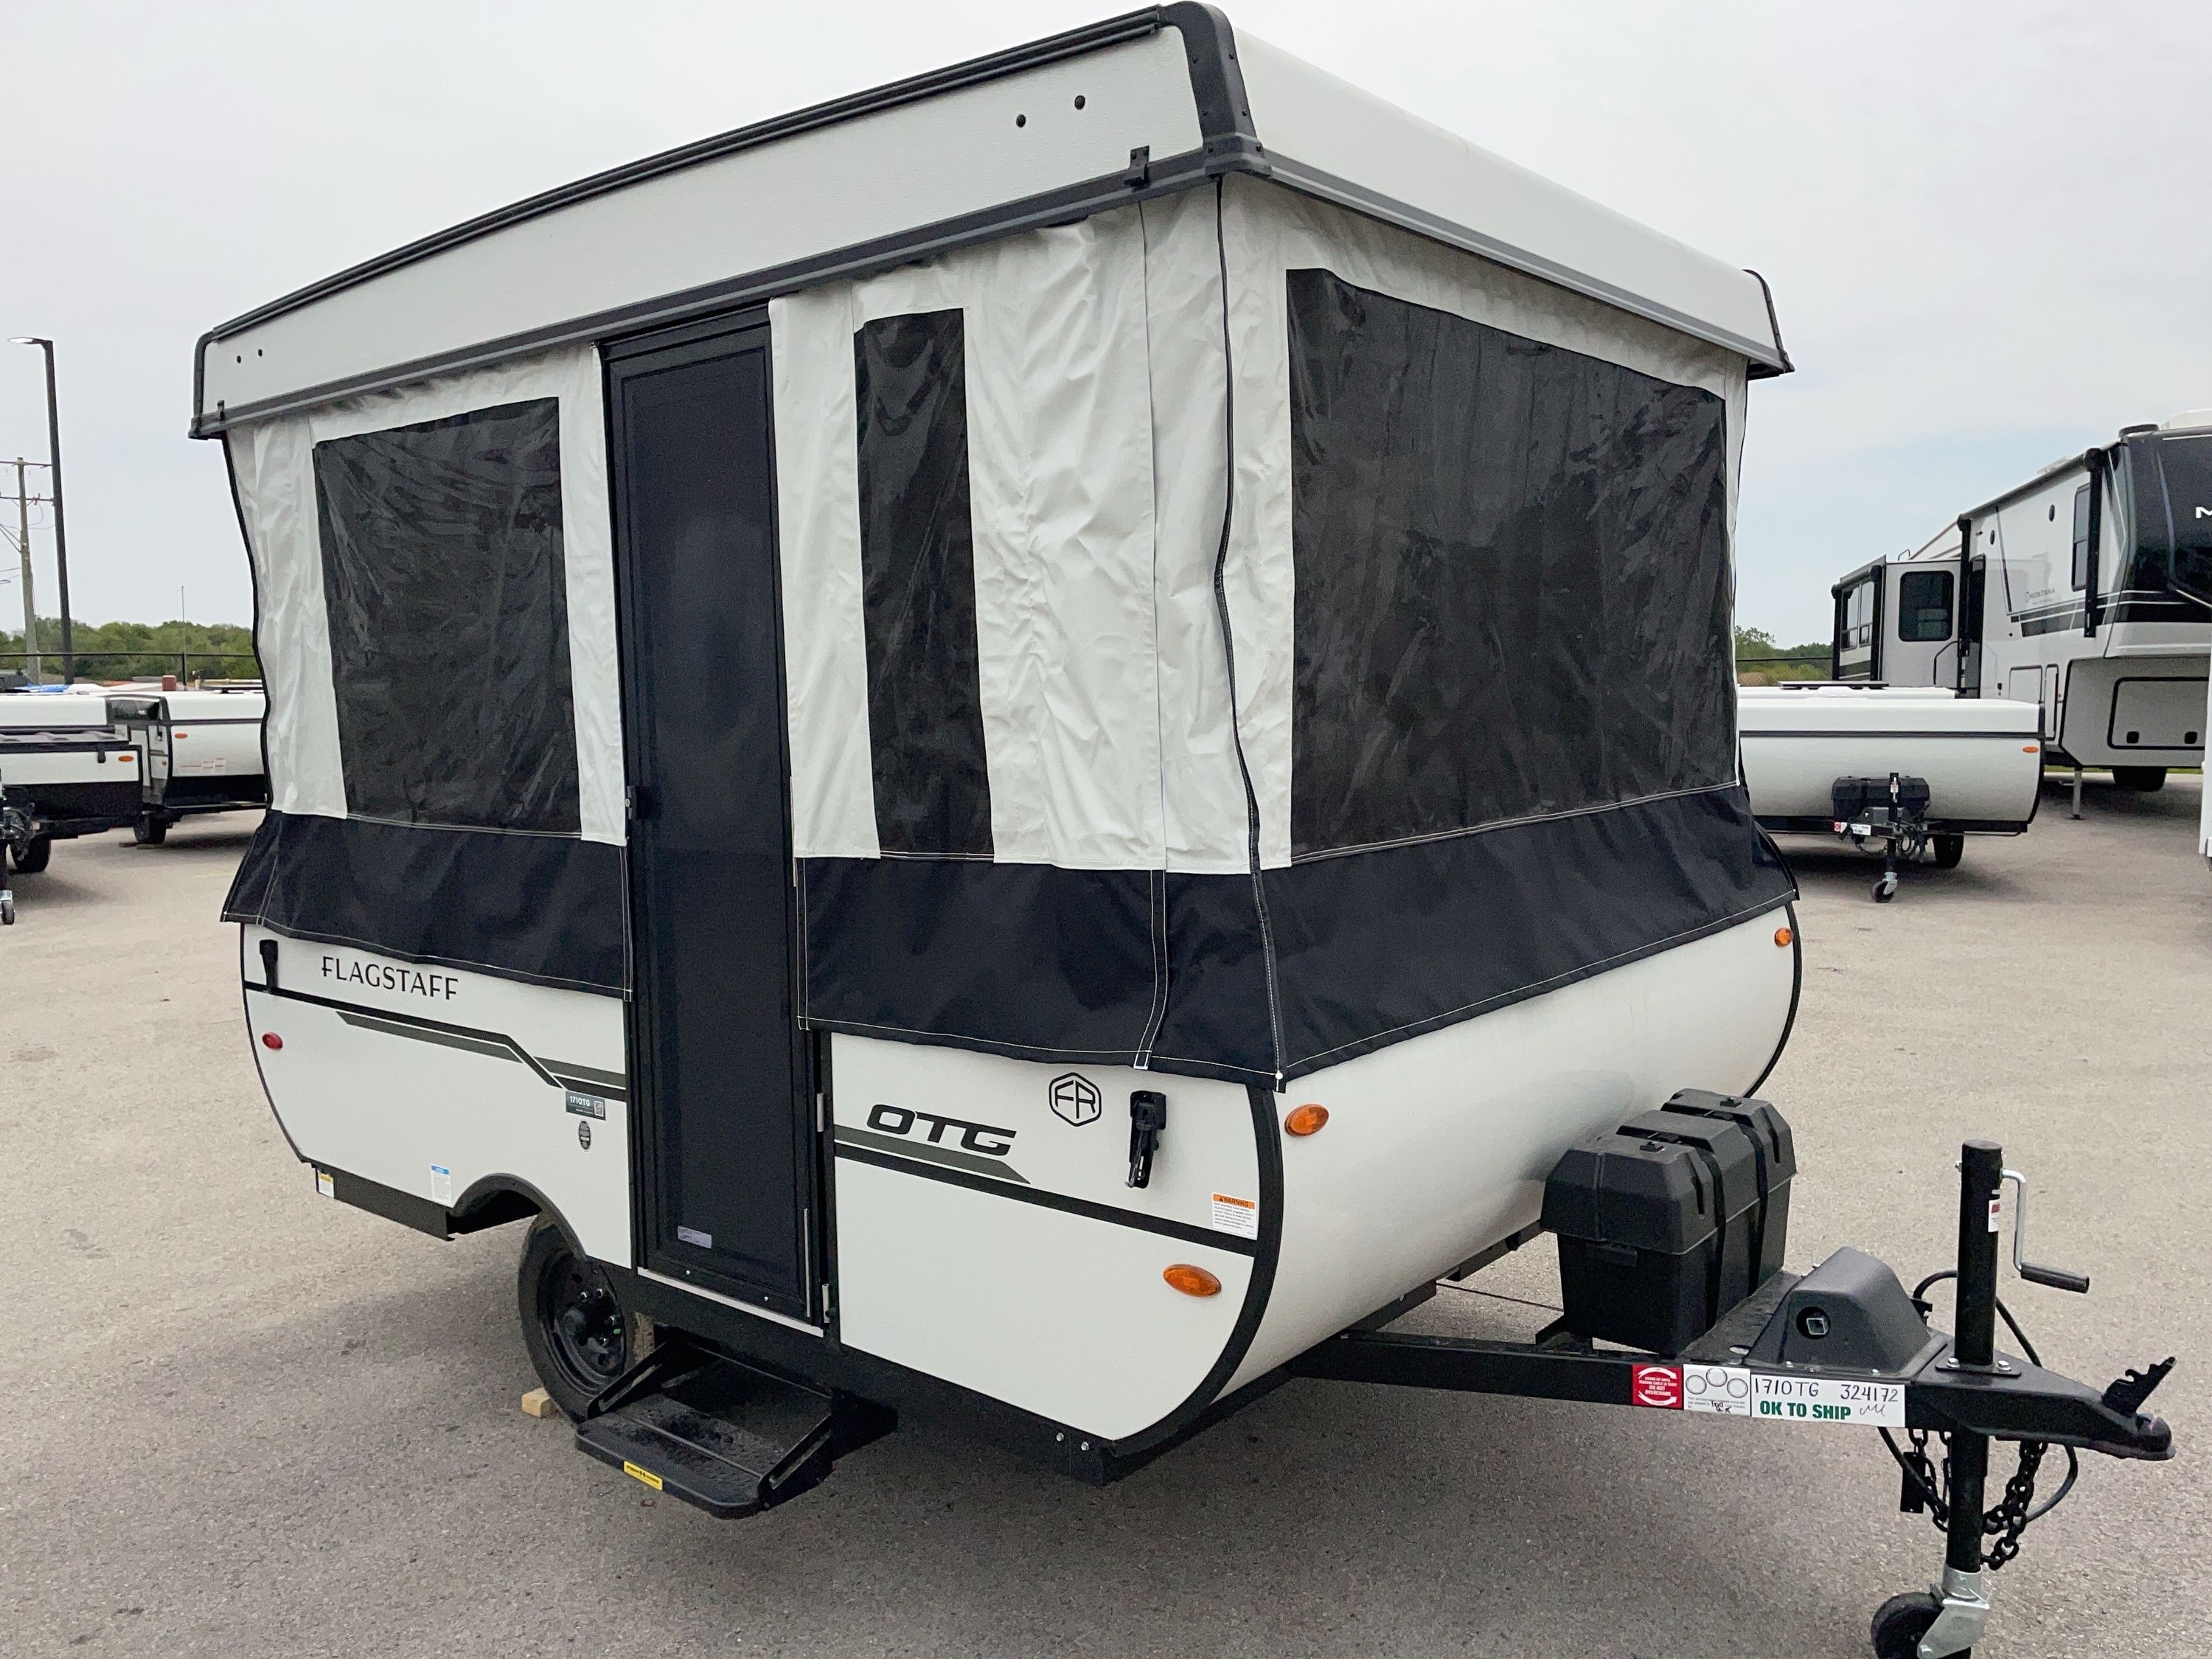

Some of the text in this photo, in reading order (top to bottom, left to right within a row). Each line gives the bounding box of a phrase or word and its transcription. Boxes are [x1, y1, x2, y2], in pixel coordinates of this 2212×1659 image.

[321, 956, 459, 1000] FLAGSTAFF
[866, 1104, 1018, 1157] OTG
[1224, 1197, 1249, 1208] WARNING
[1840, 1384, 1899, 1402] 324172
[1759, 1400, 1782, 1416] OK
[1787, 1402, 1807, 1417] TO
[1812, 1404, 1851, 1420] SHIP
